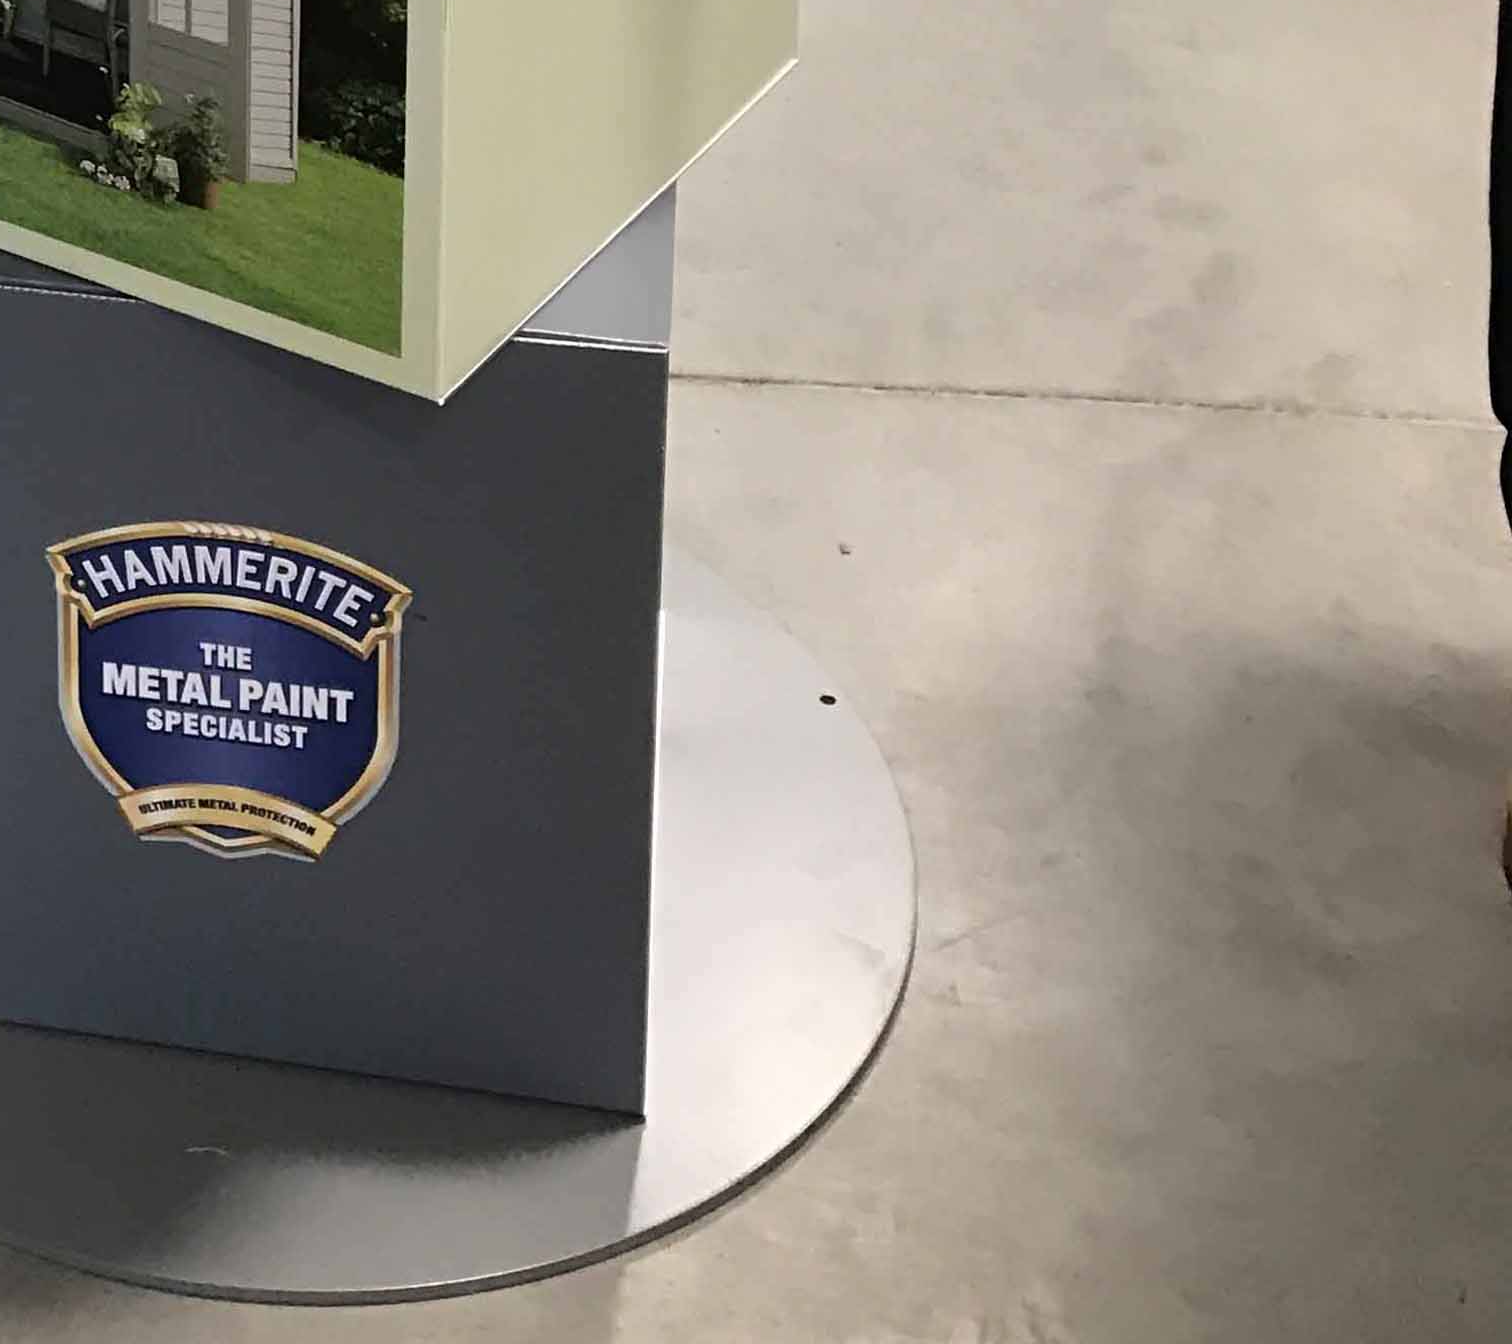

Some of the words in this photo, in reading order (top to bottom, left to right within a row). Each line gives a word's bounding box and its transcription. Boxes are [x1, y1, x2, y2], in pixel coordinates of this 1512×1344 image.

[81, 544, 375, 628] HAMMERITE
[199, 641, 253, 672] THE
[101, 661, 232, 710] METAL
[239, 678, 355, 724] PAINT
[145, 707, 309, 750] SPECIALIST
[137, 797, 197, 815] ULTIMATE
[198, 798, 238, 812] METAL
[240, 803, 317, 837] PROTECTION
